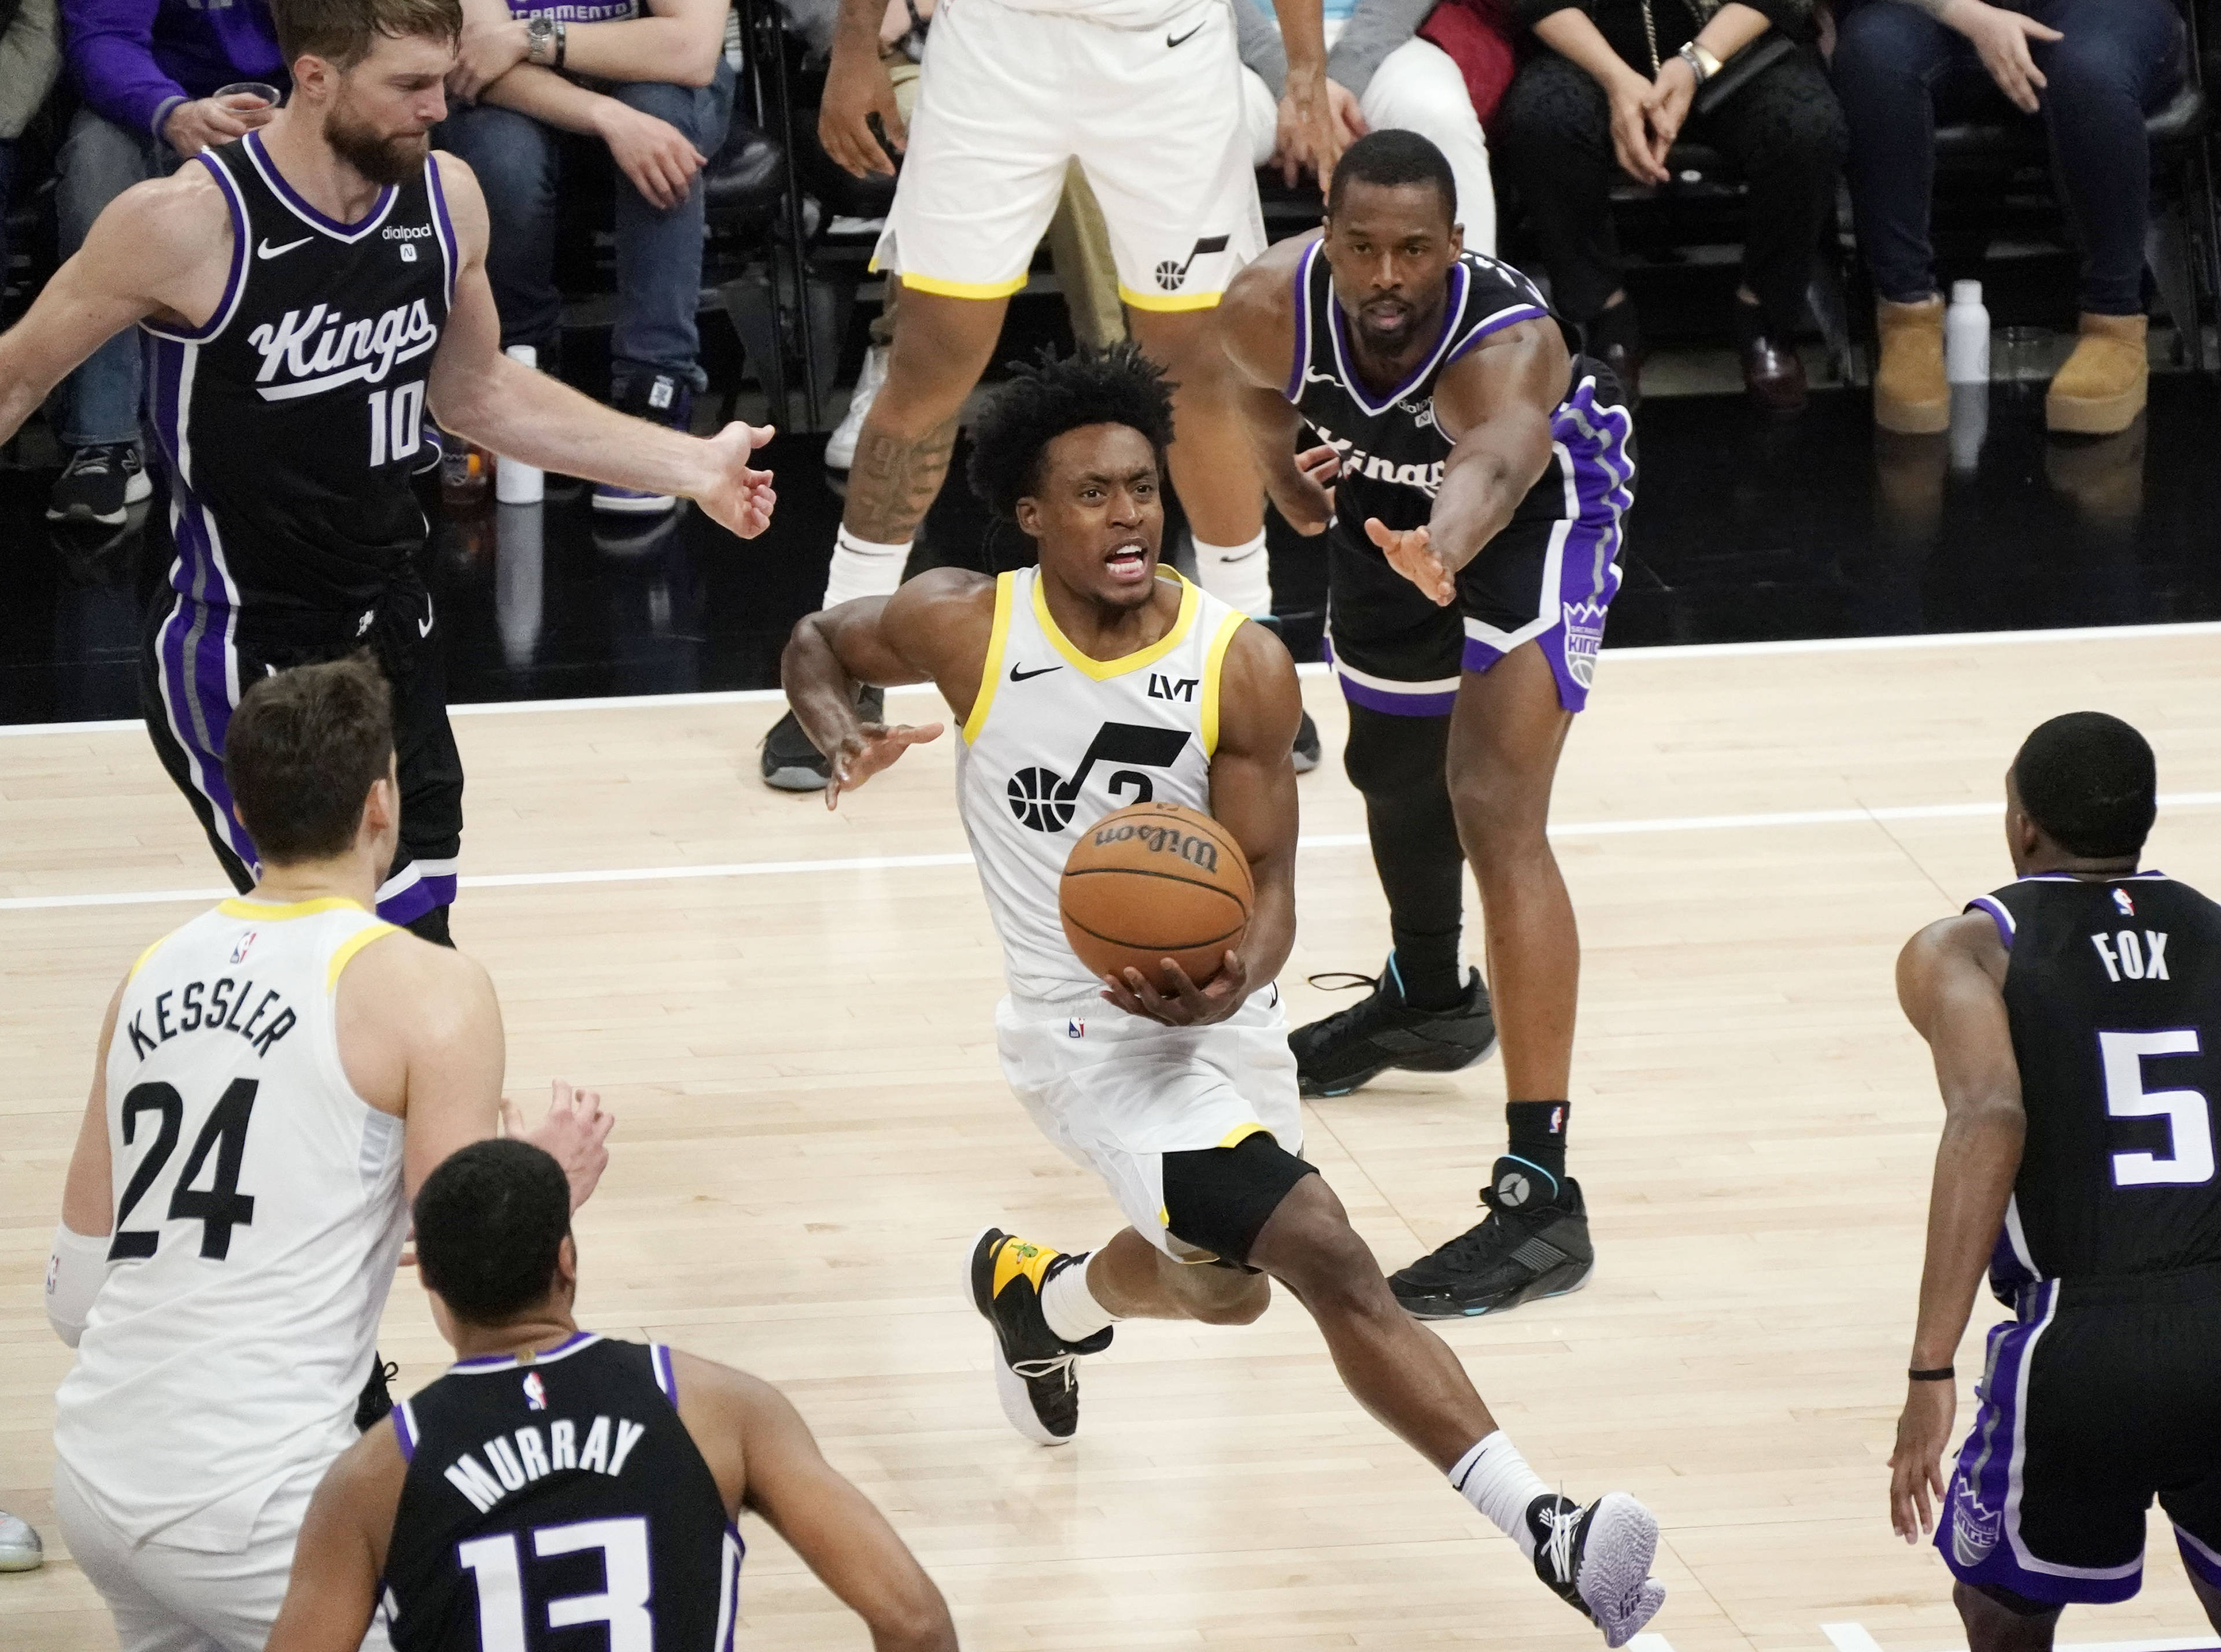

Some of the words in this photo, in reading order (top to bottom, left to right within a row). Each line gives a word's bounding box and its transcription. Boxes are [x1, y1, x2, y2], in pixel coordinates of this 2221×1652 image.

[510, 2, 627, 20] CRAMENTO
[382, 223, 432, 242] dialpad
[247, 298, 437, 401] Kings
[368, 379, 424, 467] 10
[1148, 673, 1199, 702] LVT
[1095, 824, 1217, 874] Wilson
[2091, 930, 2170, 982] FOX
[127, 977, 297, 1062] KESSLER
[2098, 1030, 2215, 1186] 5
[106, 1077, 260, 1262] 24
[444, 1416, 645, 1514] MURRAY
[458, 1517, 653, 1652] 13
